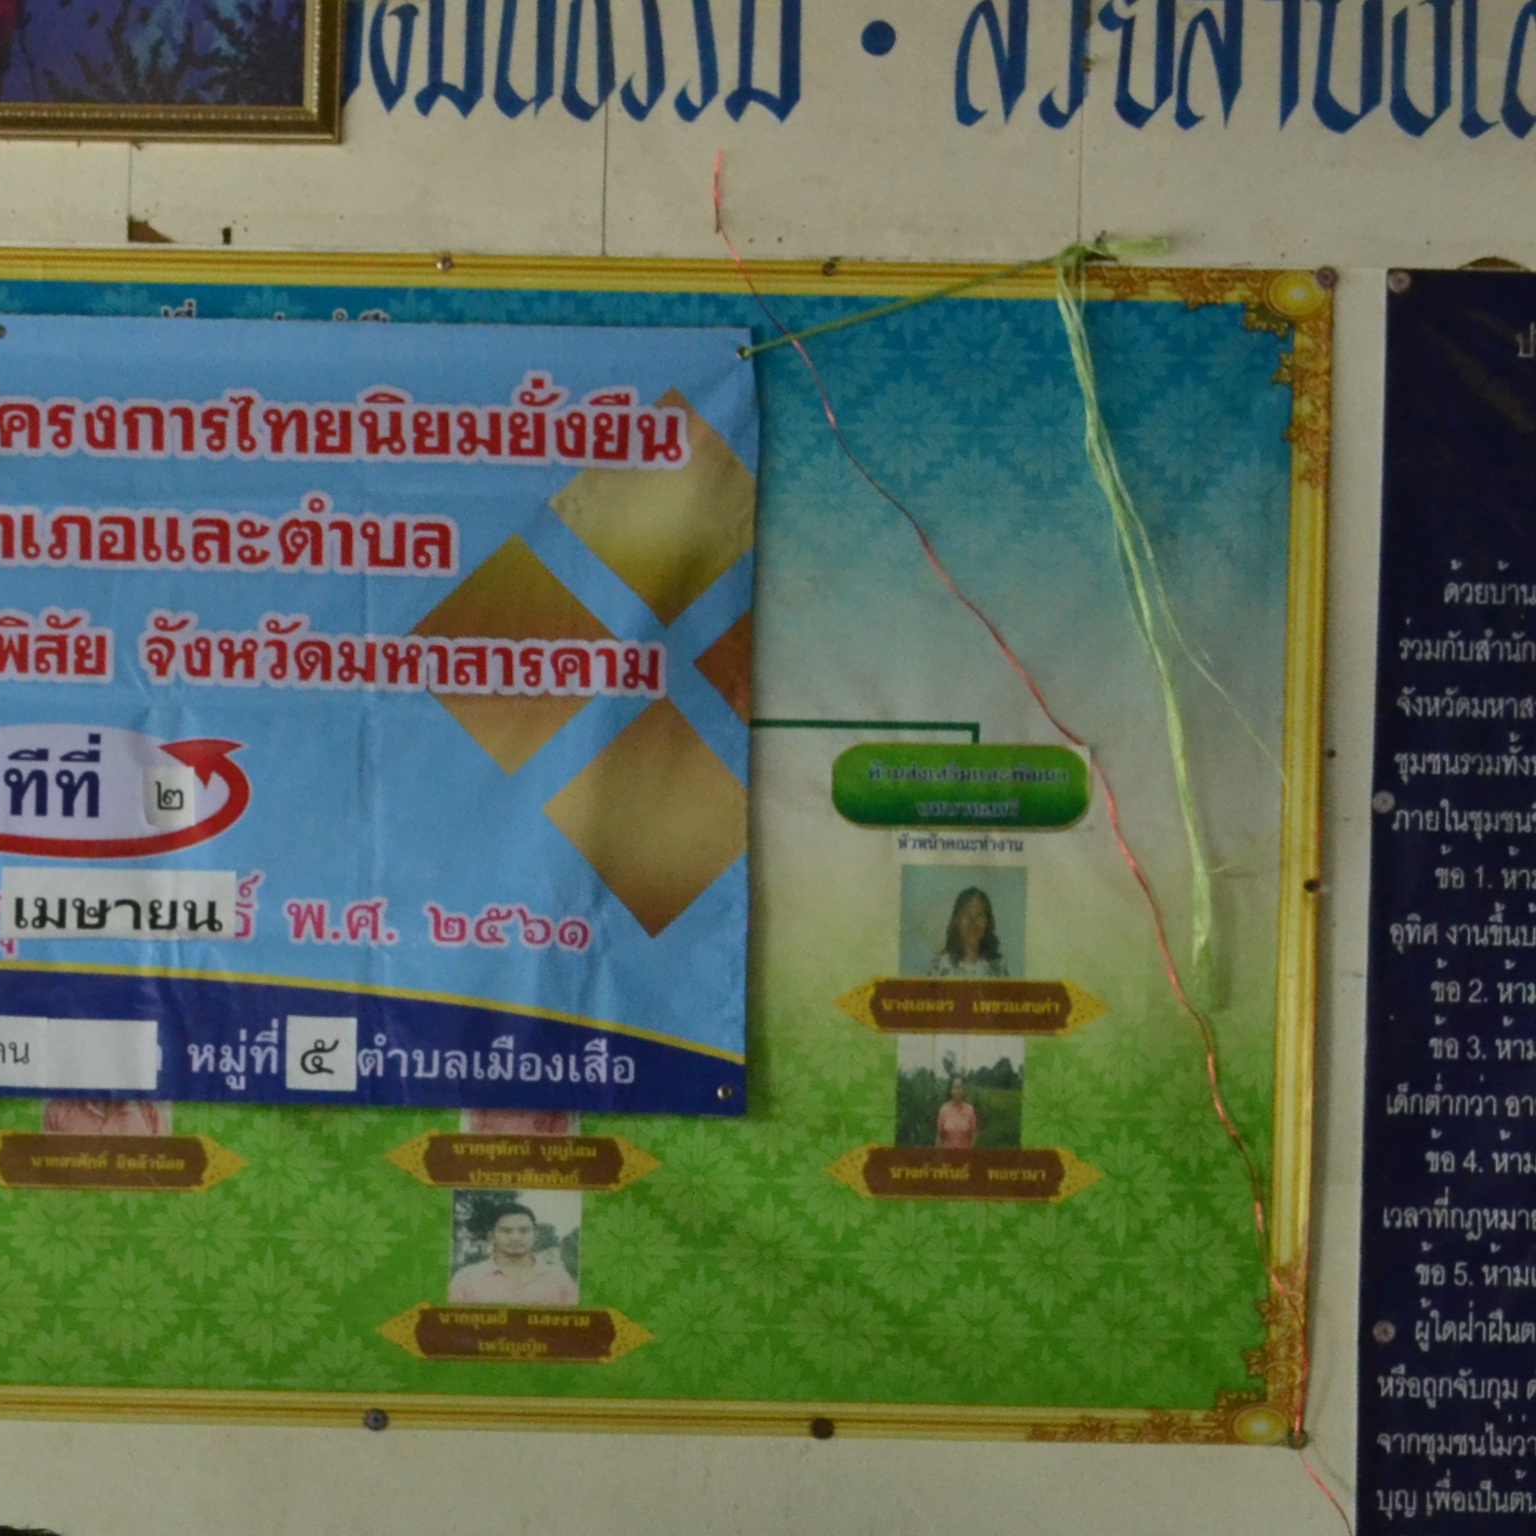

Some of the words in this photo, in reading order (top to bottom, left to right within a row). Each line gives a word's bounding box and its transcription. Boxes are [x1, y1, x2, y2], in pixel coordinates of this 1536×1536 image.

[145, 617, 661, 692] จังหวัดมหาสารคาม
[12, 895, 224, 934] เมษายน
[288, 896, 396, 942] พ.ศ.
[430, 904, 592, 950] ๒๕๖๑
[187, 1021, 280, 1088] หมู่ที่
[356, 1034, 636, 1085] ตำบลเมืองเสือ
[1377, 1364, 1518, 1409] หรือถูกจับกุม
